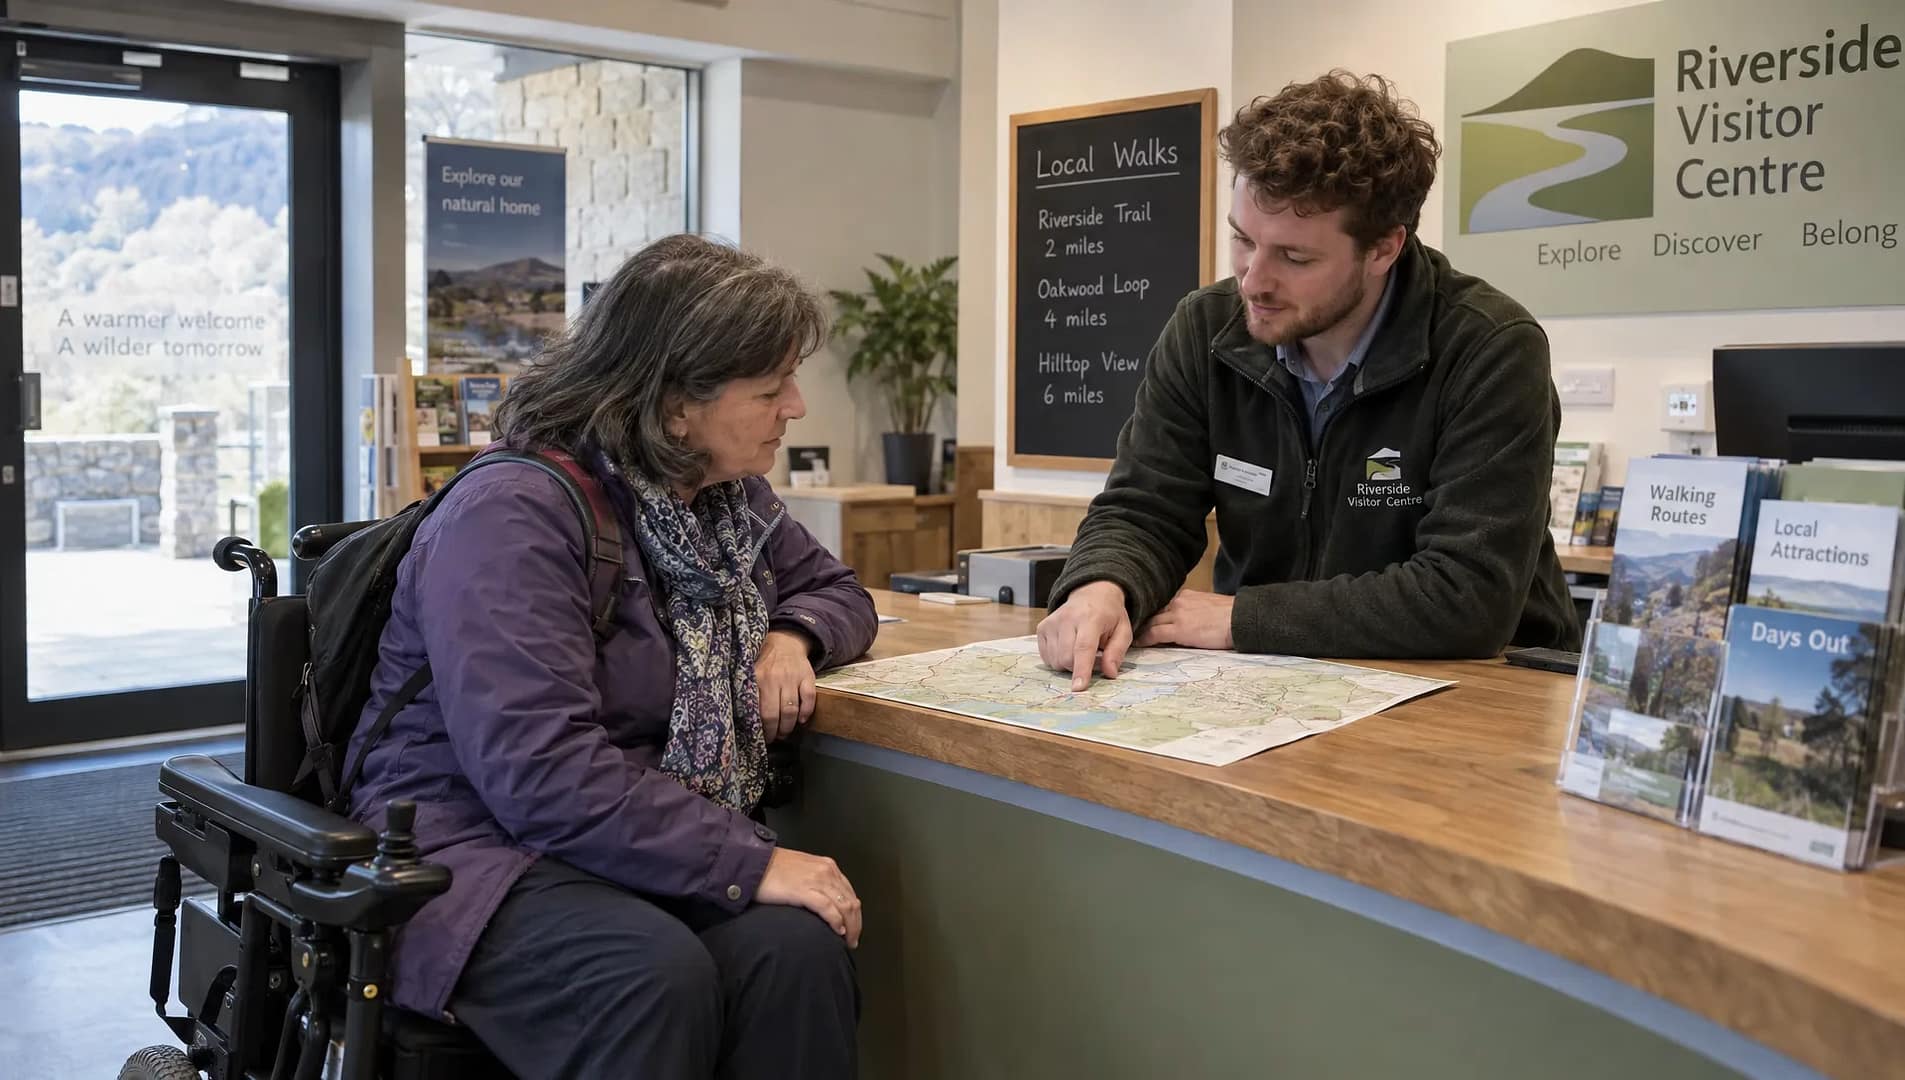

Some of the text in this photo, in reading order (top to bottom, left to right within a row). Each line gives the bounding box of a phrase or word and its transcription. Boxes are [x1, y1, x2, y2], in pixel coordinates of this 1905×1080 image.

[1677, 23, 1903, 92] Riverside
[1677, 98, 1823, 145] Visitor
[1036, 137, 1178, 179] Local Walks
[441, 165, 524, 188] Explore our
[1676, 155, 1825, 200] Centre
[442, 196, 541, 216] natural home
[1038, 202, 1151, 230] Riverside Trail
[1045, 237, 1104, 258] 2 miles
[1537, 219, 1898, 270] Explore Discover Belong
[1038, 272, 1150, 300] Oakwood Loop
[57, 308, 266, 330] A warmer welcome
[1044, 309, 1107, 329] 4 miles
[57, 336, 263, 357] A wilder tomorrow
[1038, 351, 1139, 380] Hilltop View
[1043, 384, 1104, 405] 6 miles
[1357, 483, 1411, 495] Riverside
[1650, 484, 1716, 508] Walking
[1347, 495, 1422, 507] Visitor Centre
[1650, 505, 1707, 526] Routes
[1774, 518, 1818, 538] Local
[1770, 541, 1869, 567] Attractions
[1751, 621, 1850, 654] Days Out
